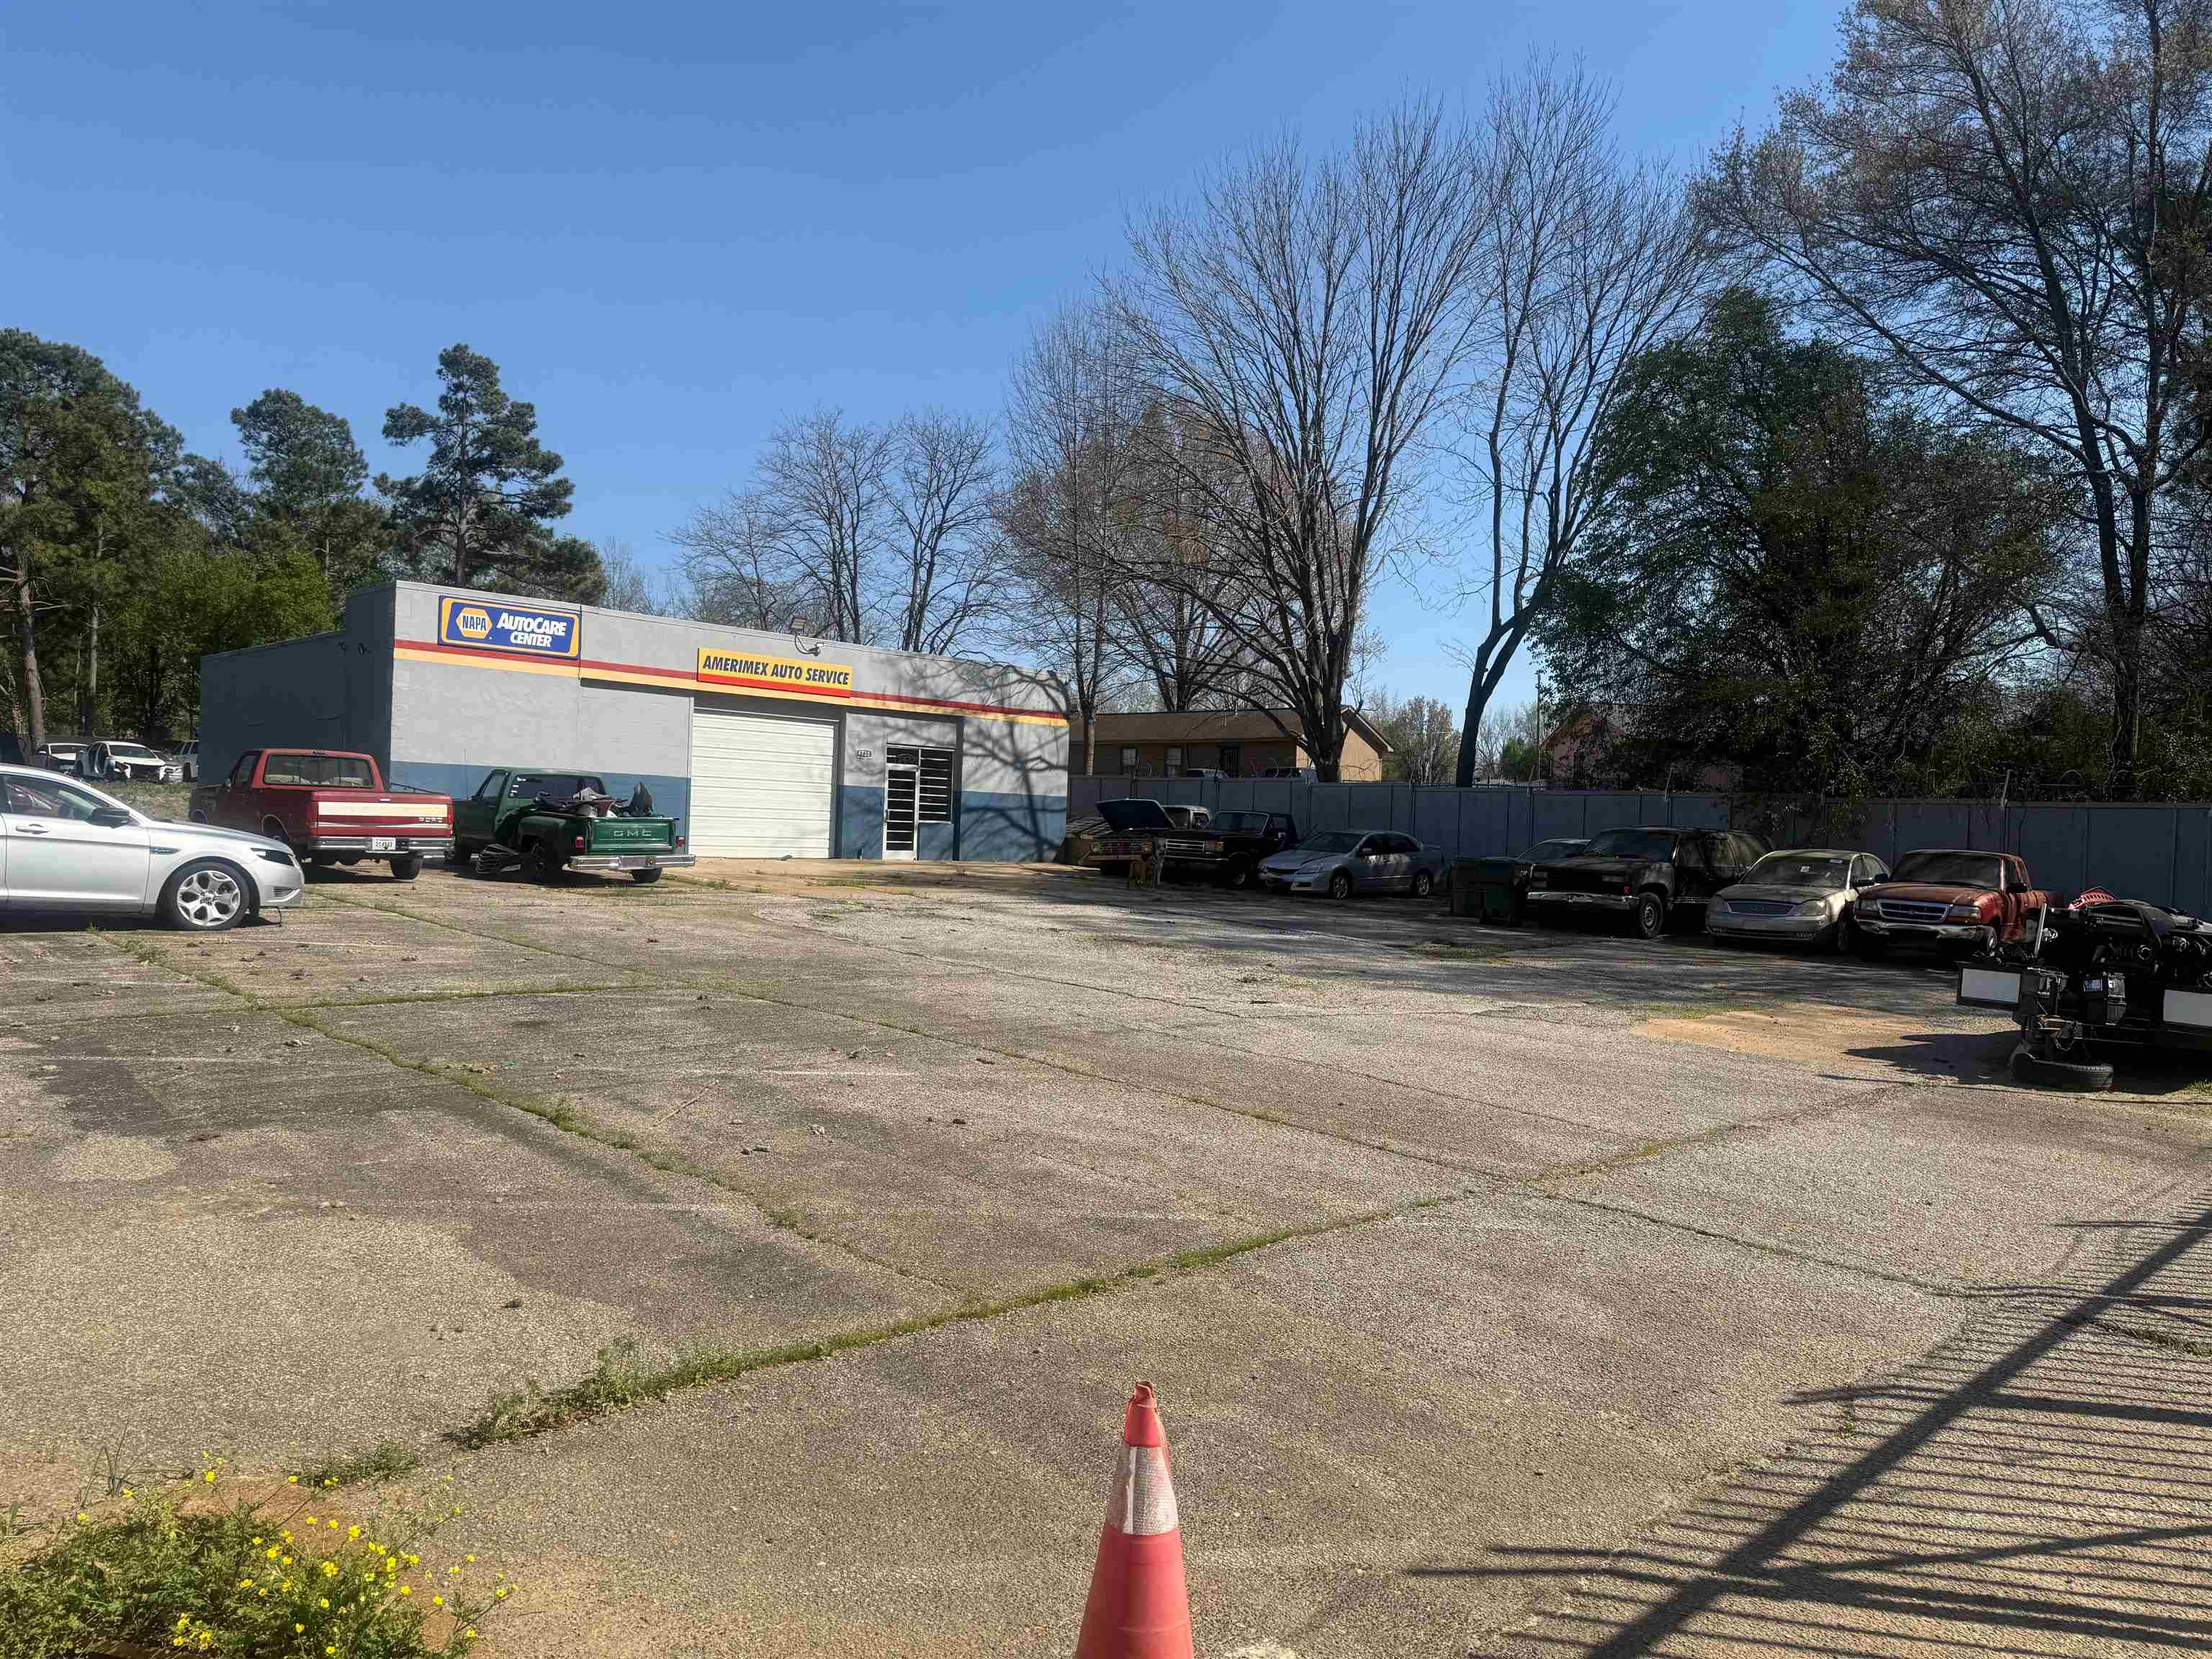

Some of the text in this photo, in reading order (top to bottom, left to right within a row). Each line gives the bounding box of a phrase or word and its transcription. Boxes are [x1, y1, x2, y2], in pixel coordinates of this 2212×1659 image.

[462, 615, 486, 631] NAPA
[511, 631, 552, 647] CENTER
[703, 655, 850, 685] AMERIMEX AUTO SERVICE
